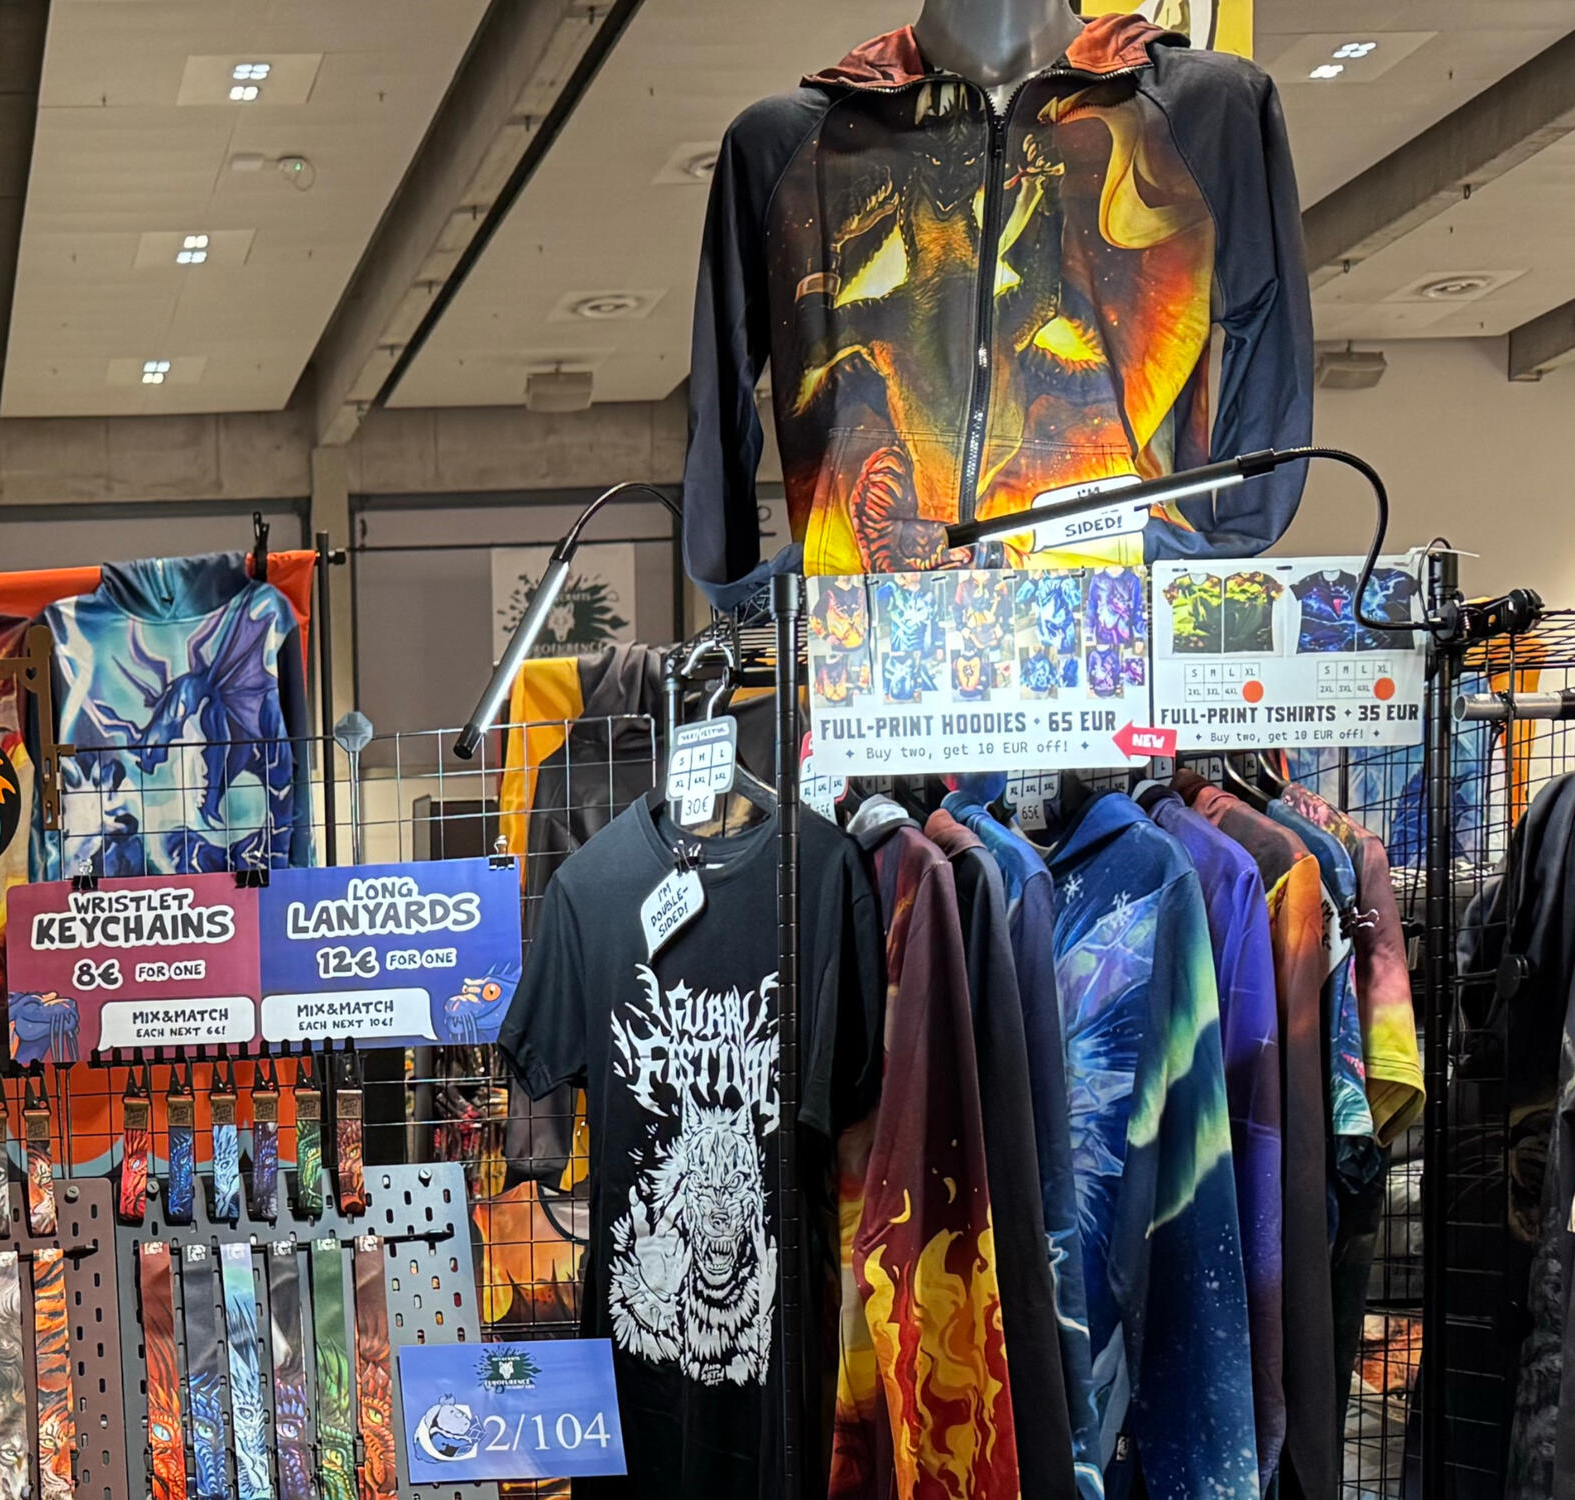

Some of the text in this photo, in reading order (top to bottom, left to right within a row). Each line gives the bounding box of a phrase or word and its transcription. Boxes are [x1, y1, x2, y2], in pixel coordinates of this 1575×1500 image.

[1065, 516, 1123, 538] SIDED!
[1245, 667, 1256, 676] XL
[1378, 664, 1389, 673] XL
[820, 710, 1116, 740] FULL-PRINT HOODIES 65 EUR
[1161, 704, 1419, 725] FULL-PRINT TSHIRTS 35 EUR
[1132, 733, 1165, 748] NEW
[1210, 729, 1364, 744] Buy two, get 10 EUR off!
[866, 740, 1068, 762] Buy two, get 10 EUR off!
[685, 795, 709, 816] 30€
[1022, 804, 1040, 820] 65€
[352, 882, 414, 901] LONG
[73, 893, 189, 915] WRISTLET
[650, 886, 688, 927] DOUBLE-
[291, 898, 476, 934] LANYARDS
[658, 901, 688, 938] SIDED!
[36, 910, 230, 945] KEYCHAINS
[320, 950, 453, 975] 12€ FOR ONE
[76, 961, 202, 987] 8€ FOR ONE
[132, 1008, 229, 1024] MIX&MATCH
[297, 1000, 394, 1018] MIX&MATCH
[136, 1025, 226, 1038] EACH NEXT 6€!
[298, 1021, 327, 1031] EACH
[332, 1019, 364, 1029] NEXT
[484, 1411, 611, 1452] 2/104
